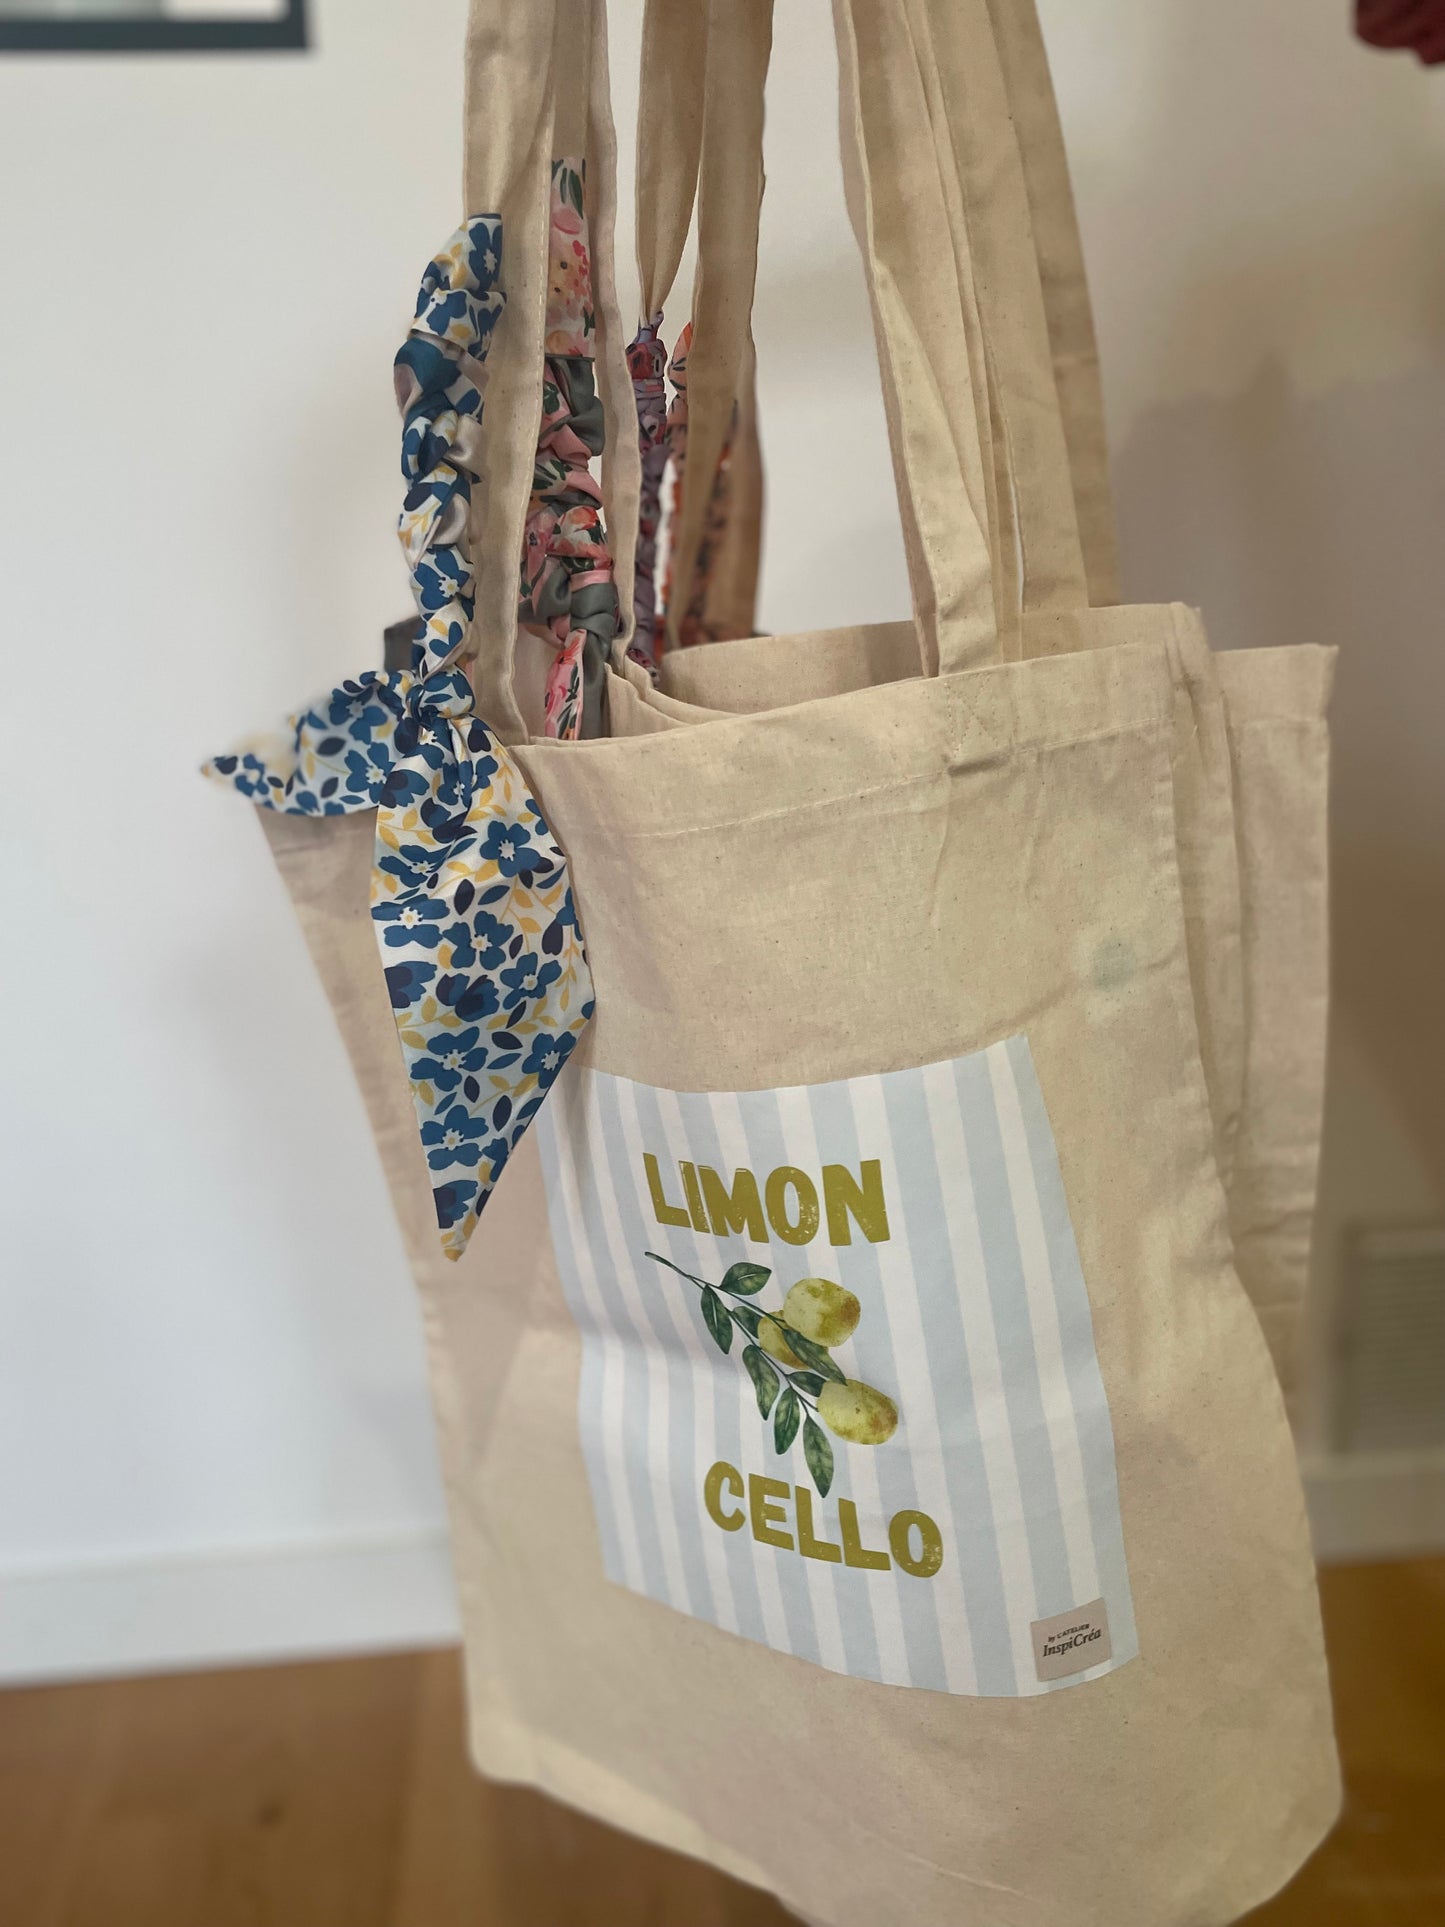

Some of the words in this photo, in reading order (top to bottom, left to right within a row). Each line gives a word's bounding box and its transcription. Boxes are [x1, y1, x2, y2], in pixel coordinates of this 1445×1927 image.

[642, 1152, 891, 1247] LIMON
[704, 1461, 944, 1578] CELLO
[1043, 1628, 1102, 1657] InspiCréa
